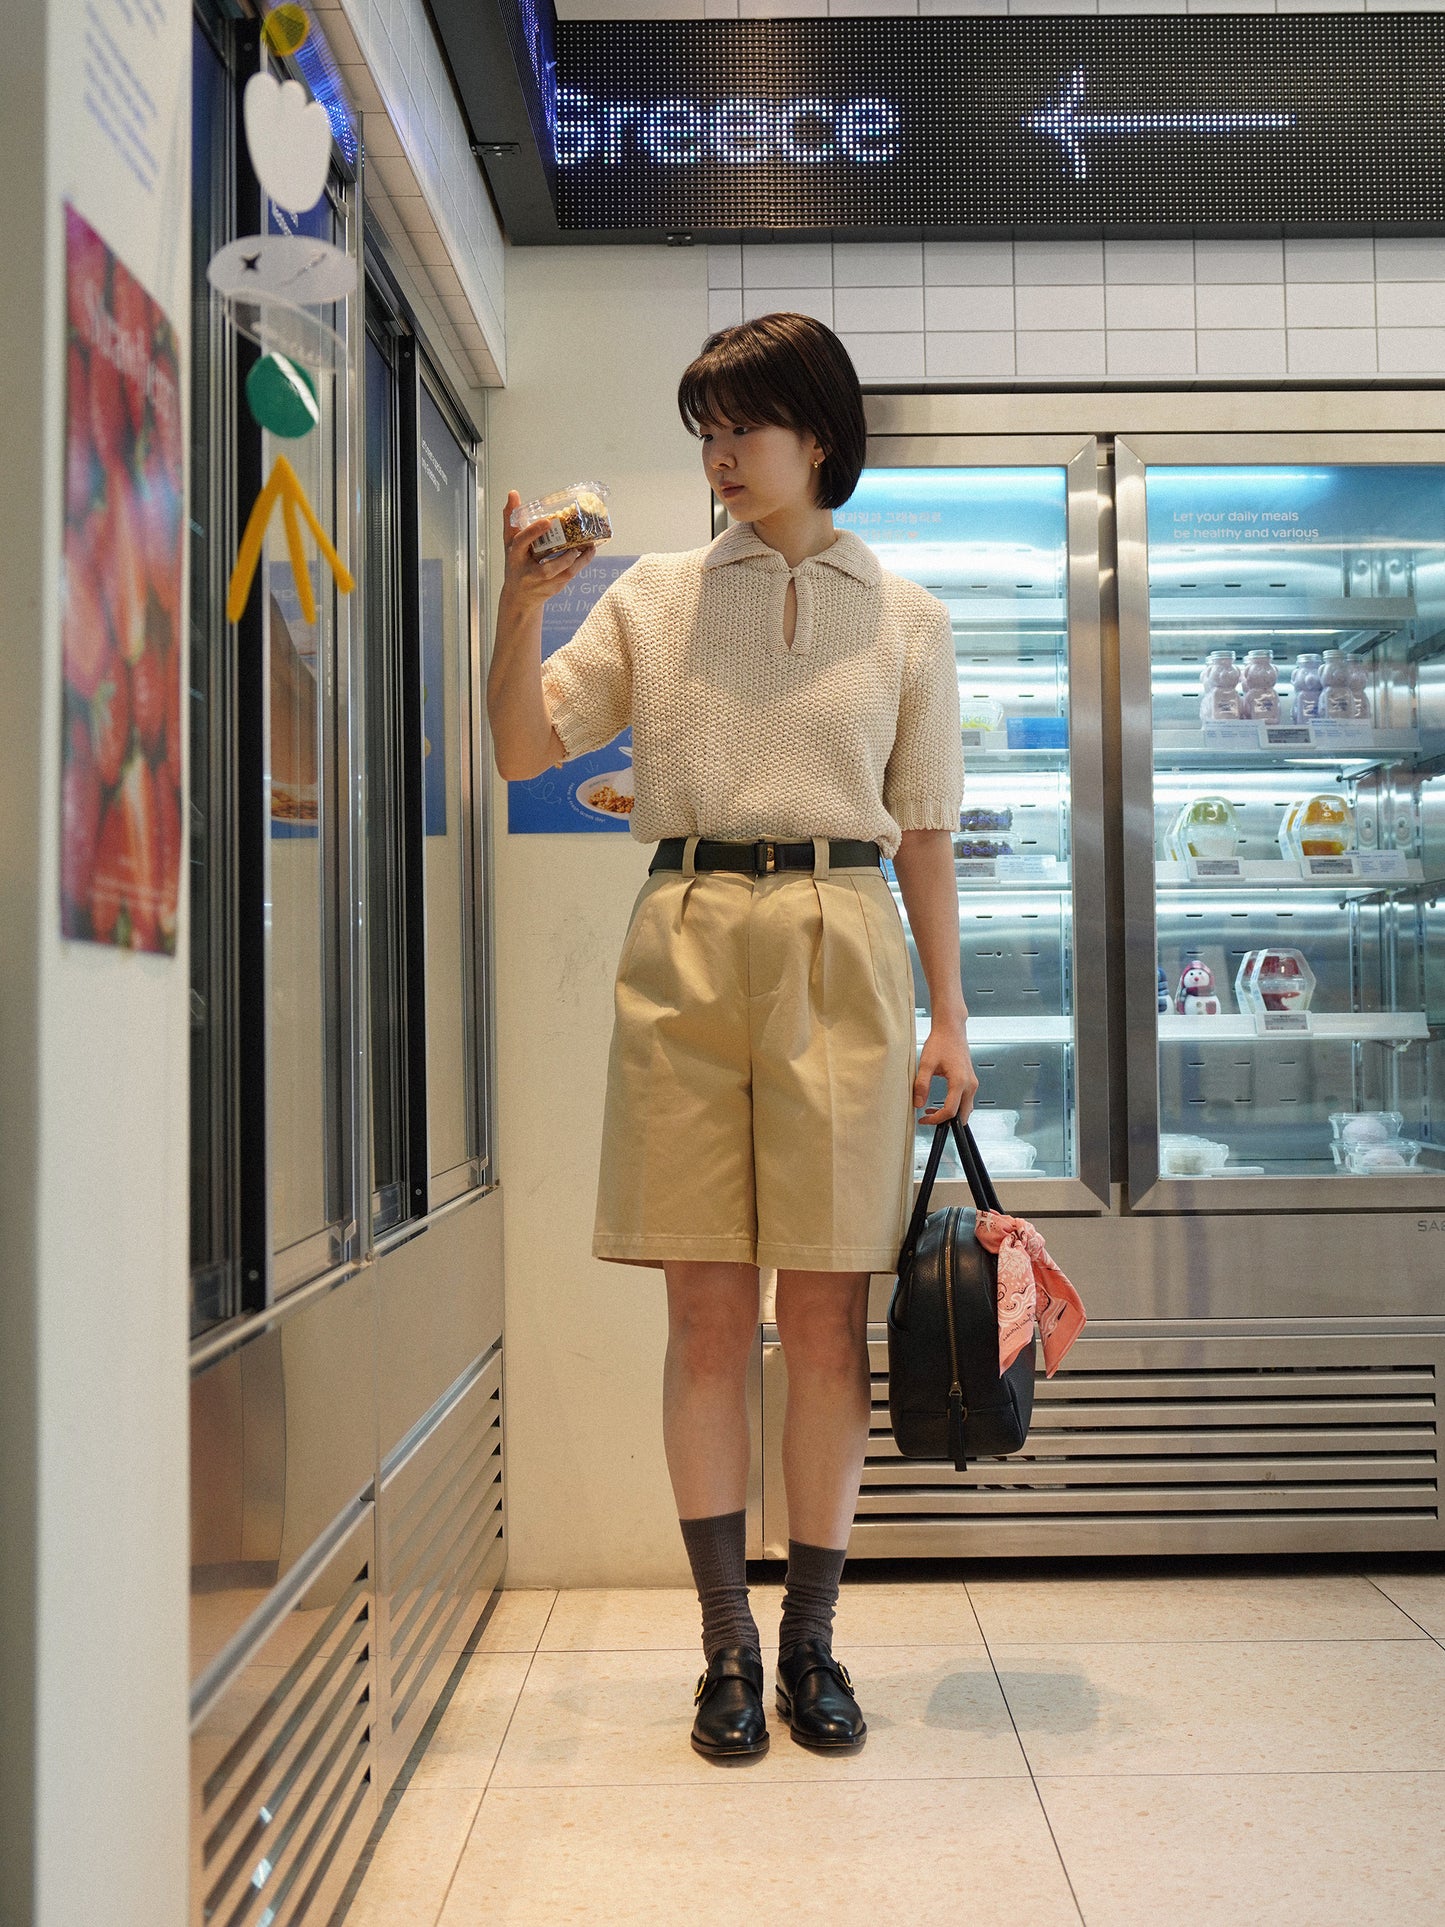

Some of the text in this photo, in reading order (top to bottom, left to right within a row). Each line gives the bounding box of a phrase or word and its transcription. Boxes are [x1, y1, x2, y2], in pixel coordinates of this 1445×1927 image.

[1173, 511, 1299, 523] Let your daily meals
[1174, 527, 1319, 540] be healthy and various
[579, 567, 607, 579] uits
[581, 582, 607, 594] Gre
[546, 599, 571, 612] resh
